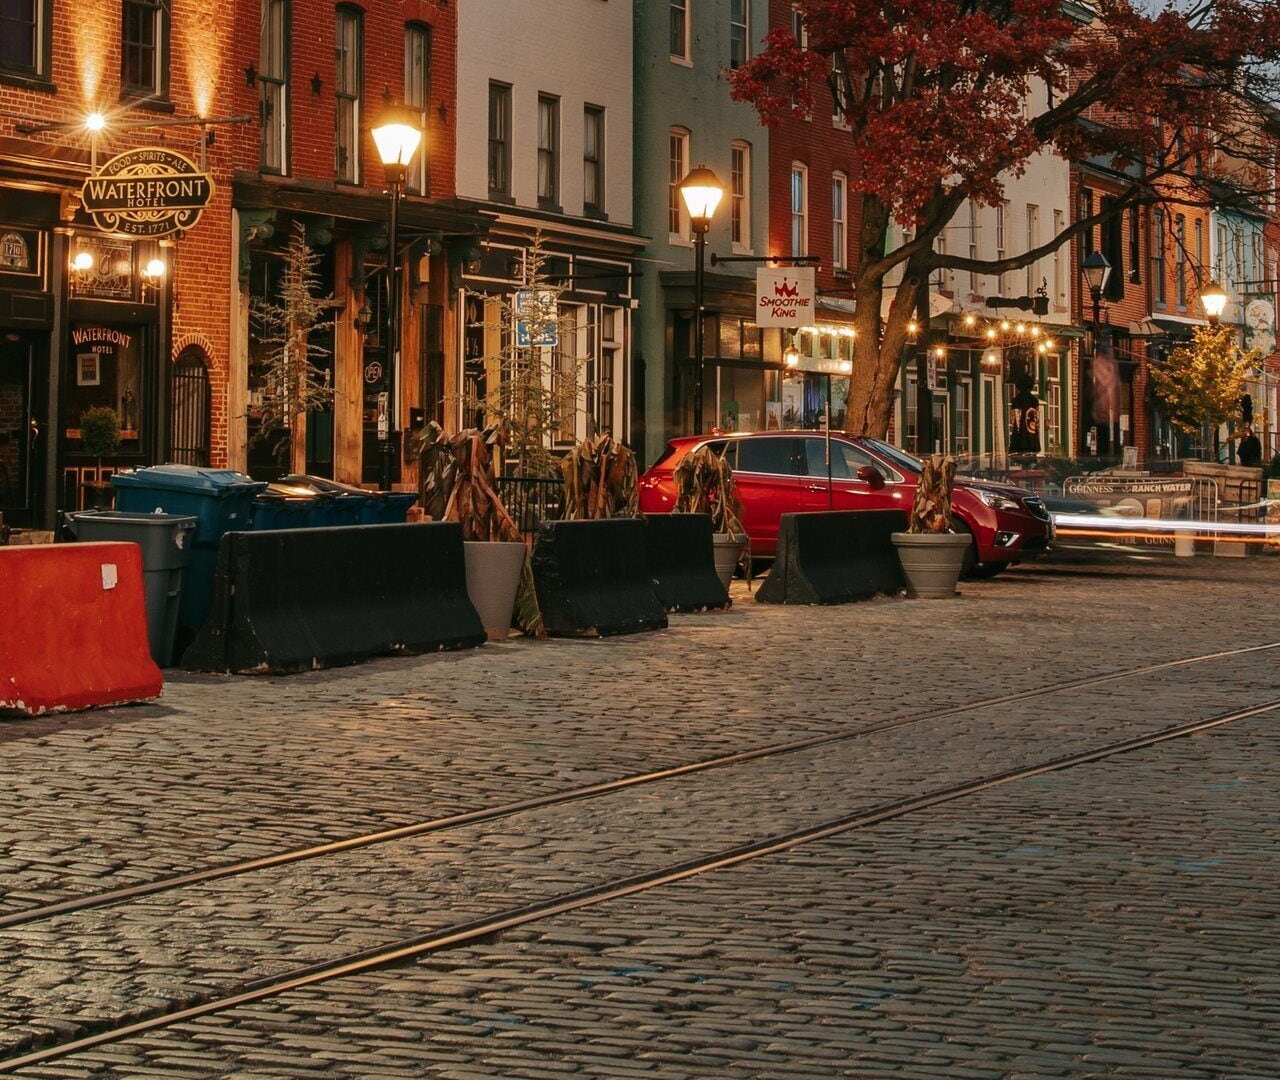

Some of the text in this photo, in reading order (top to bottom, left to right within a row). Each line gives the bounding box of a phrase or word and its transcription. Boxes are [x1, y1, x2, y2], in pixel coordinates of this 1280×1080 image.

[109, 151, 188, 175] FOOD SPIRITS ALE
[89, 179, 206, 200] WATERFRONT
[127, 198, 166, 208] HOTEL
[124, 223, 170, 235] EST. 1771
[759, 296, 811, 307] SMOOTHIE
[72, 328, 132, 348] WATERFRONT
[92, 345, 113, 354] HOTEL
[1068, 483, 1191, 494] GUINNESS RANCH WATER
